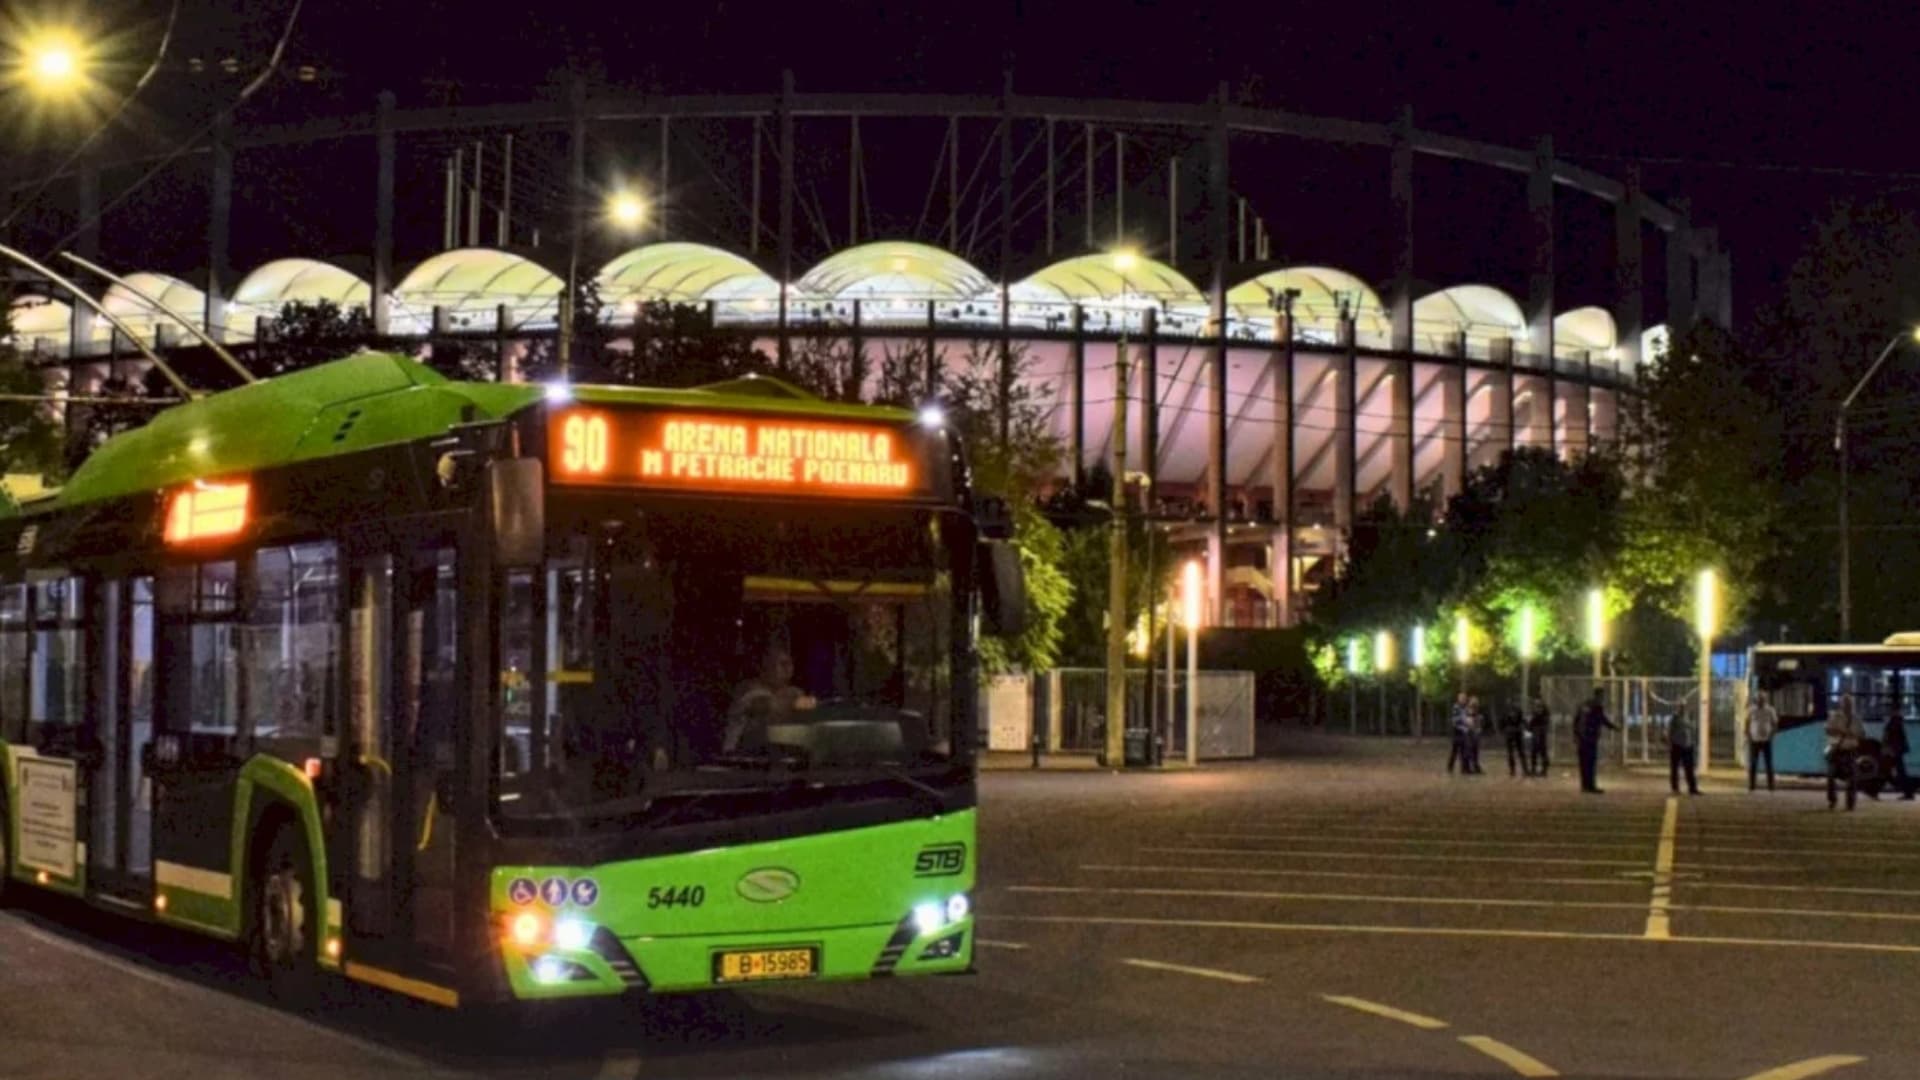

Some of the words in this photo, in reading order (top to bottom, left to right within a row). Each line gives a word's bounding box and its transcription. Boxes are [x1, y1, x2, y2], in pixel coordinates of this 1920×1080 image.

[563, 415, 607, 472] 90
[663, 421, 747, 454] ARENA
[757, 427, 890, 463] NATIONALA
[641, 450, 663, 475] M
[671, 452, 794, 482] PETRACHE
[803, 460, 909, 487] POENARU
[915, 848, 962, 872] STB
[647, 885, 705, 909] 5440
